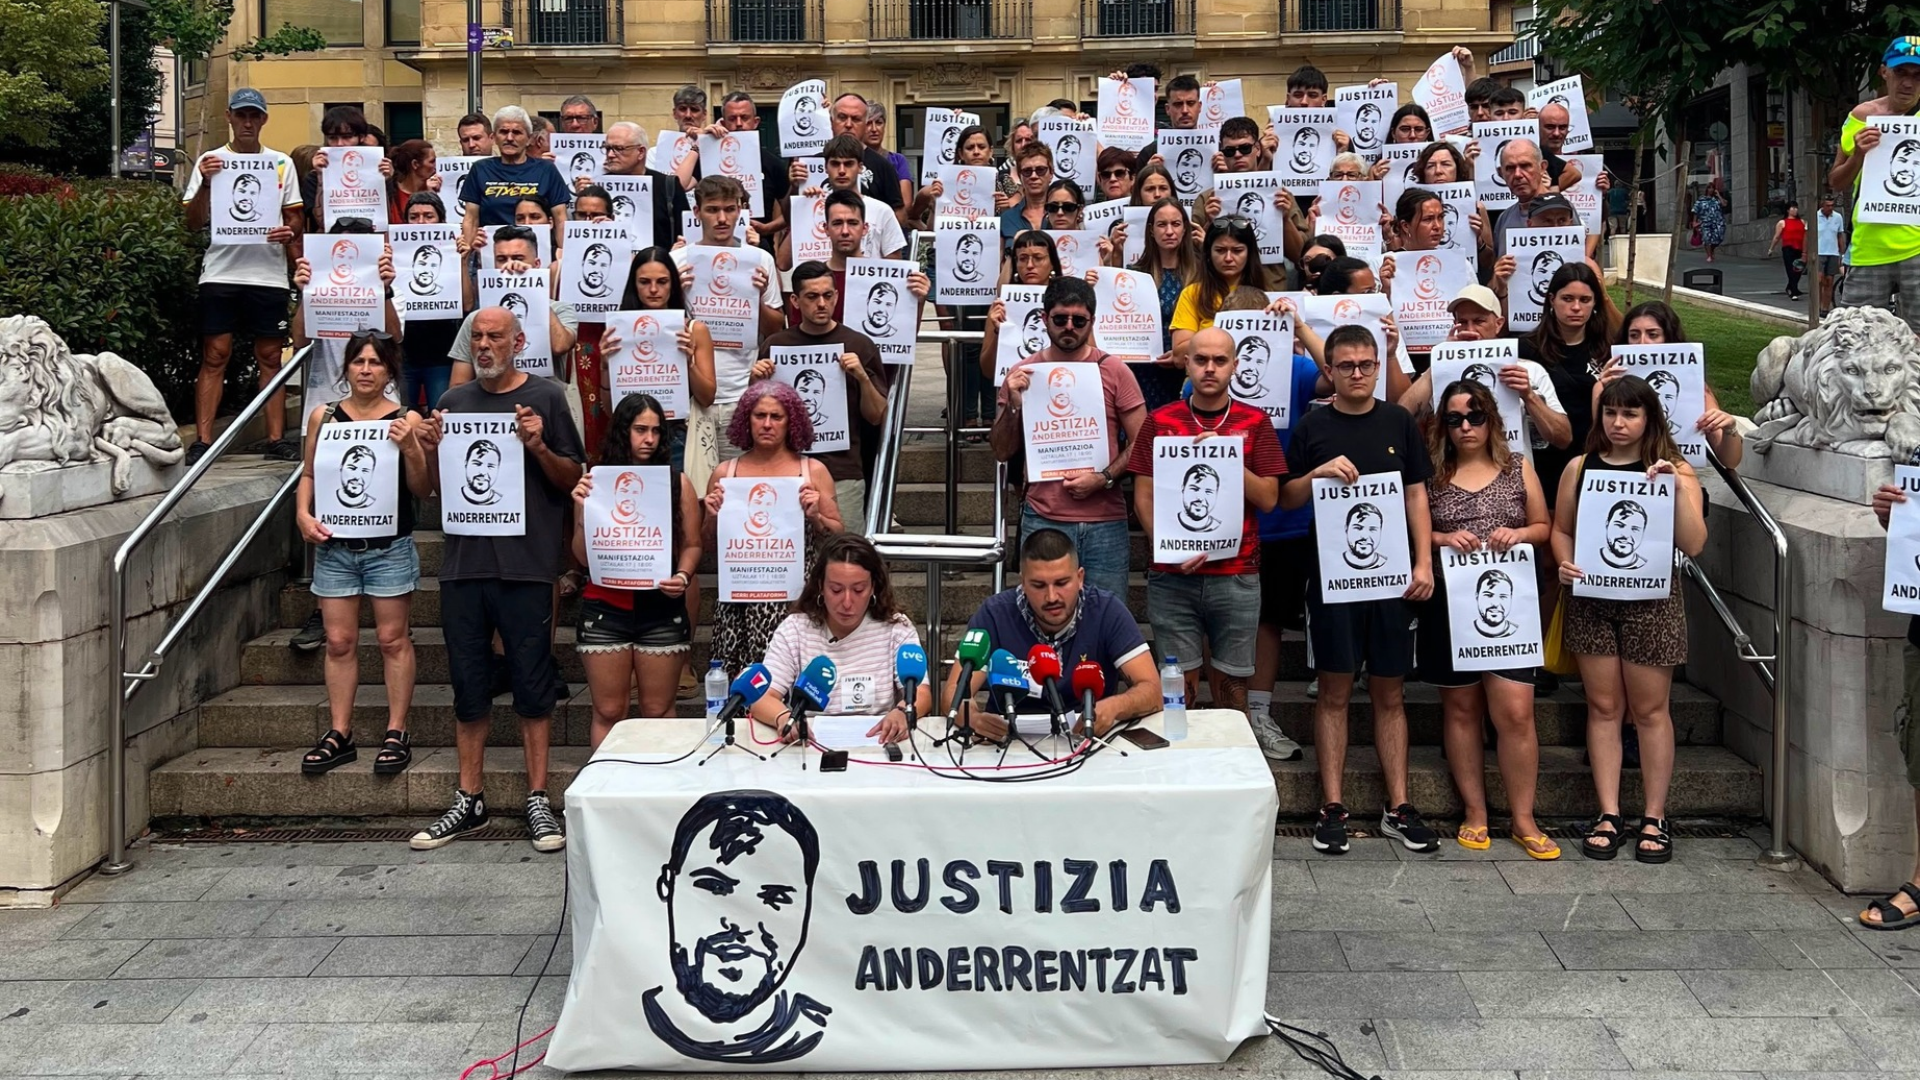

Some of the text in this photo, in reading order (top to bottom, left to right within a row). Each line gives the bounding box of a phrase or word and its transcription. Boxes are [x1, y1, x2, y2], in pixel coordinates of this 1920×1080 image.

[1339, 89, 1394, 102] JUSTIZIA
[1531, 80, 1578, 100] JUSTIZIA
[1426, 92, 1463, 109] JUSTIZIA
[929, 113, 976, 126] JUSTIZIA
[1103, 117, 1148, 126] JUSTIZIA
[1278, 114, 1334, 124] JUSTIZIA
[1042, 122, 1094, 132] JUSTIZIA
[1477, 126, 1535, 138] JUSTIZIA
[1875, 123, 1919, 134] USTI
[554, 139, 607, 149] JUSTIZIA
[784, 140, 829, 150] ANDERRENTZ
[1161, 135, 1216, 145] JUSTIZIA
[1563, 134, 1589, 147] ENTZAT
[1387, 149, 1421, 160] JUSTI
[222, 160, 275, 170] USTIZIA
[439, 162, 472, 172] JUSTI
[596, 182, 649, 192] USTIZIA
[1219, 178, 1278, 190] JUSTIZIA
[1282, 178, 1321, 187] NDERRENT
[329, 189, 380, 198] JUSTIZIA
[485, 186, 538, 198] ETXERA
[1437, 188, 1472, 200] TIZIA
[1479, 192, 1518, 202] ANDERRE
[1564, 194, 1596, 202] TIZIA
[941, 206, 988, 216] JUSTIZIA
[1088, 204, 1125, 220] JUSTI
[1864, 203, 1920, 214] ANDERREN
[216, 226, 273, 236] ANDERRENTZA
[940, 221, 996, 231] JUSTIZIA
[1322, 225, 1375, 235] JUSTIZIA
[394, 231, 457, 242] JUSTIZIA
[568, 228, 627, 239] JUSTIZIA
[799, 241, 832, 251] JUSTI
[1511, 234, 1580, 248] JUSTIZIA
[850, 265, 913, 279] JUSTIZIA
[482, 277, 544, 289] JUSTIZIA
[311, 287, 376, 297] JUSTIZIA
[940, 287, 997, 296] ANDERRENTZAT
[692, 296, 751, 309] JUSTIZIA
[1005, 292, 1046, 304] JUSTI
[407, 301, 459, 311] DERRENTZAT
[574, 303, 619, 313] DERRENTZ
[1400, 300, 1450, 312] JUSTIZI
[1099, 314, 1154, 324] JUSTIZIA
[1219, 319, 1289, 332] JUSTIZIA
[876, 344, 912, 355] RENTZAT
[1437, 346, 1513, 361] JUSTIZIA
[516, 358, 548, 368] ENTZAT
[773, 352, 840, 365] JUSTIZIA
[1618, 352, 1698, 366] JUSTIZIA
[617, 364, 679, 376] JUSTIZIA
[616, 375, 681, 384] ANDERRENTZAT
[443, 421, 517, 434] JUSTIZIA
[1033, 416, 1098, 433] JUSTIZIA
[813, 430, 845, 442] ENTZAT
[1031, 428, 1100, 441] ANDERRENTZAT
[1037, 443, 1094, 454] MANIFESTAZIOA
[1159, 445, 1238, 458] JUSTIZIA
[1319, 481, 1398, 500] JUSTIZIA
[1587, 479, 1669, 497] JUSTIZIA
[321, 514, 393, 526] ANDERRENTZAT
[447, 512, 521, 524] ANDERRENTZAT
[592, 526, 662, 538] JUSTIZIA
[726, 538, 795, 550] JUSTIZIA
[1160, 538, 1238, 551] ANDERRENTZAT
[1448, 549, 1529, 567] JUSTIZIA
[1327, 573, 1408, 591] ANDERRENTZAT
[1580, 573, 1666, 589] ANDERRENTZAT
[902, 651, 923, 662] tve
[1040, 651, 1057, 660] rne
[1458, 642, 1539, 659] ANDERRENTZAT
[1002, 677, 1021, 686] etb
[845, 857, 1182, 915] JUSTIZIA
[855, 944, 1199, 995] ANDERRENTZAT
